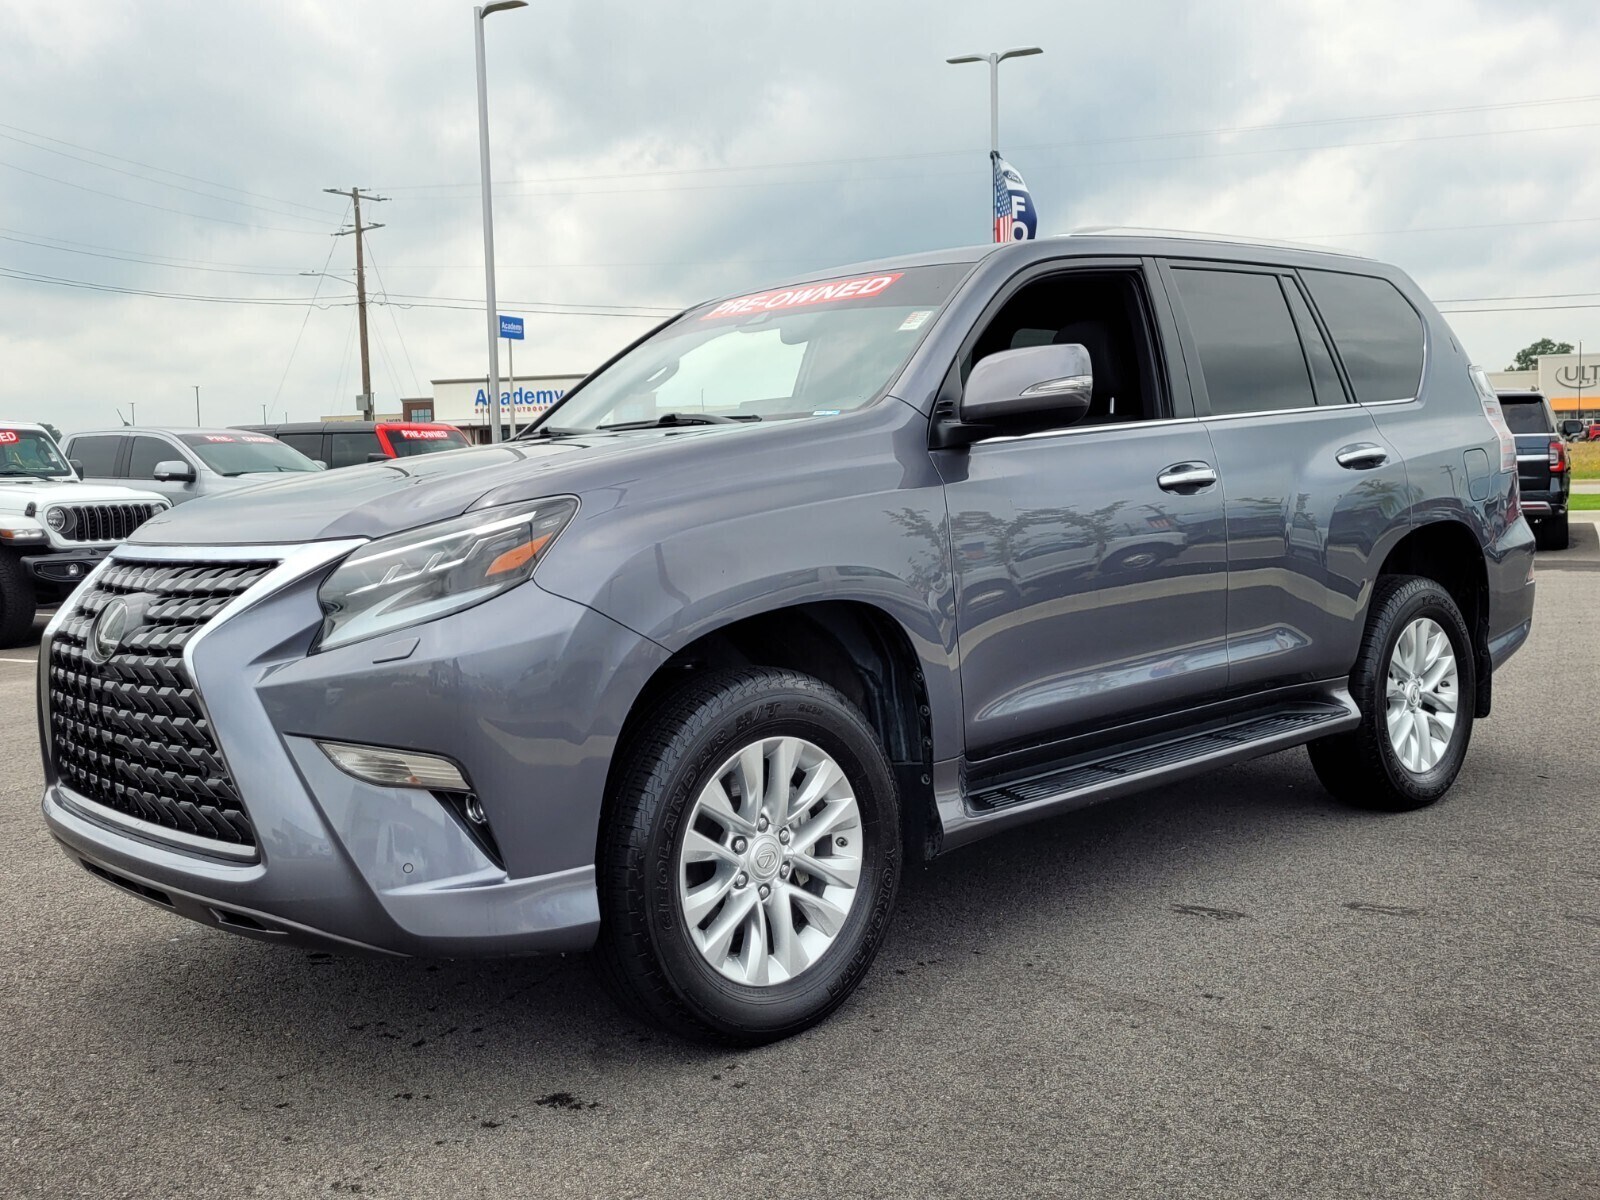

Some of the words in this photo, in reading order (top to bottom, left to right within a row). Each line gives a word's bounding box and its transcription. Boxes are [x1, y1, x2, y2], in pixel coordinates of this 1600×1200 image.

[707, 276, 893, 317] PRE-OWNED
[475, 387, 564, 406] Aademy
[402, 430, 448, 438] PRE-OWNED
[827, 848, 896, 998] YOKOHAMA
